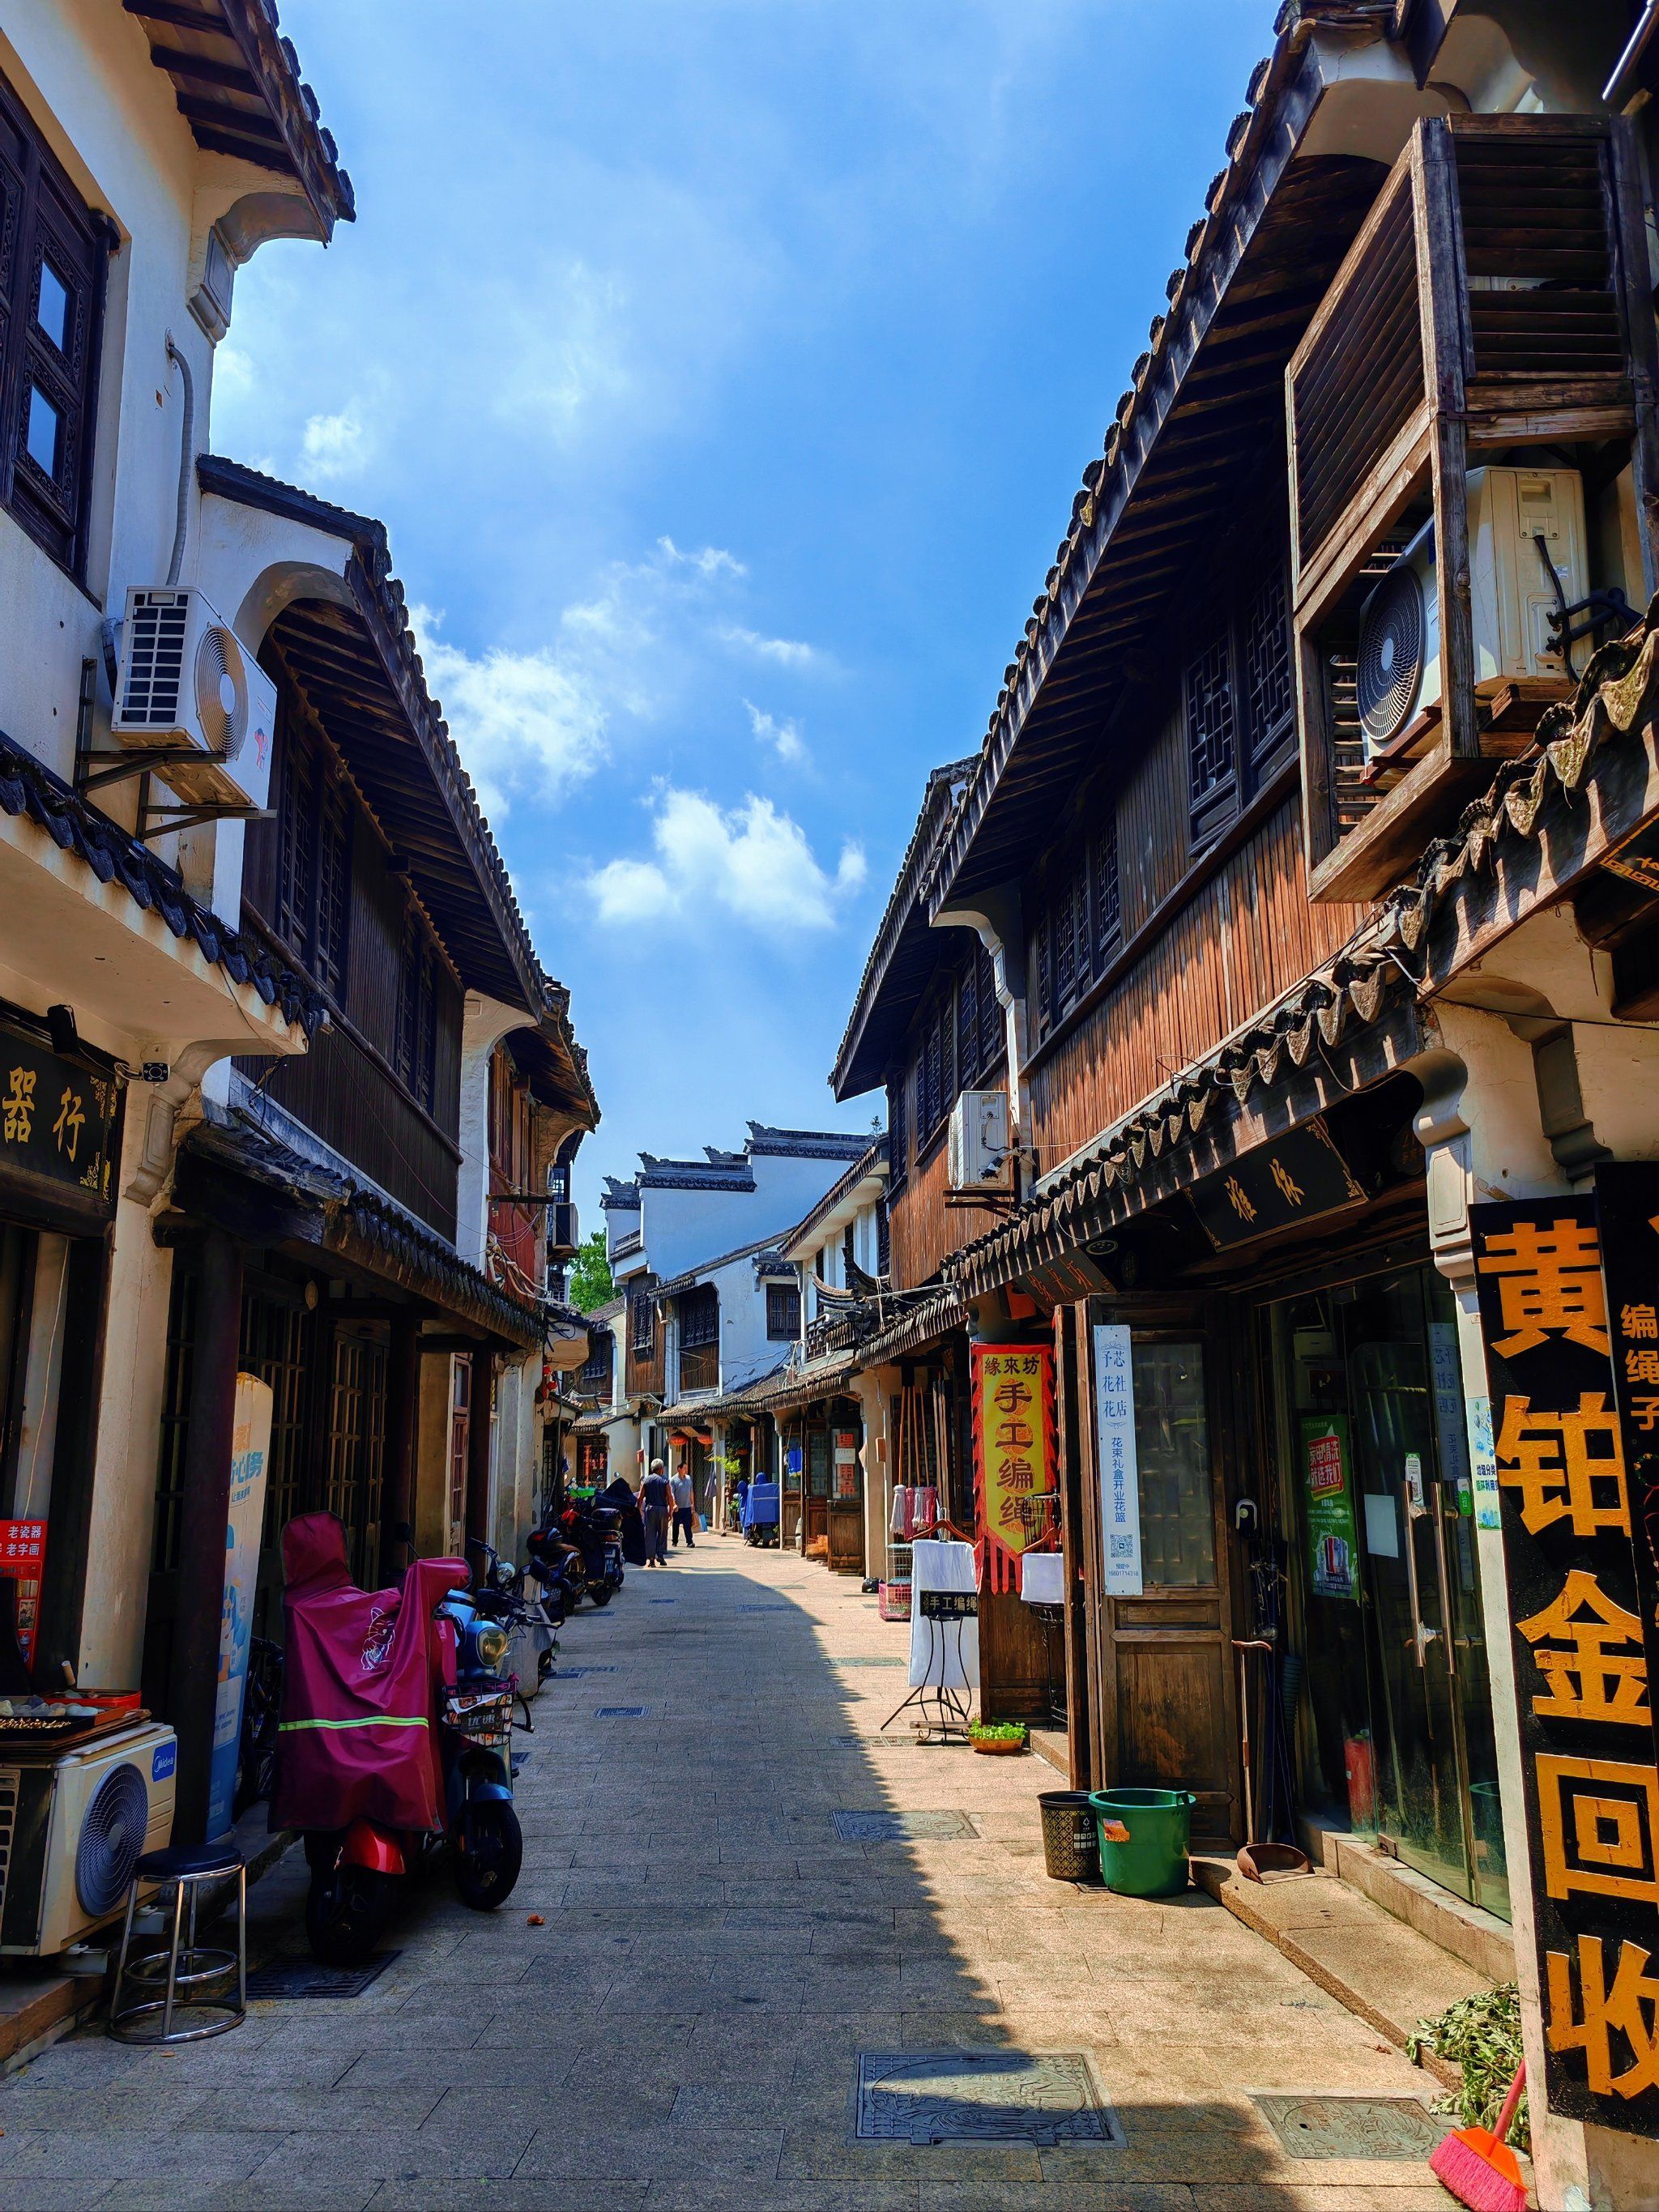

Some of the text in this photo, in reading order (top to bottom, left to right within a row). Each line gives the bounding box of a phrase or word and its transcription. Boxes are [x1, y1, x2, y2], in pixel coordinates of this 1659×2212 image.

[984, 1356, 1039, 1375] 緣來坊
[1102, 1375, 1127, 1392] 花社
[1102, 1400, 1127, 1417] 花店
[994, 1381, 1037, 1528] 手工编绳
[1111, 1437, 1126, 1523] 花束礼盒开业花篮
[8, 1525, 41, 1539] 老瓷器
[6, 1542, 41, 1556] 老字画
[929, 1596, 978, 1612] 手工编绳
